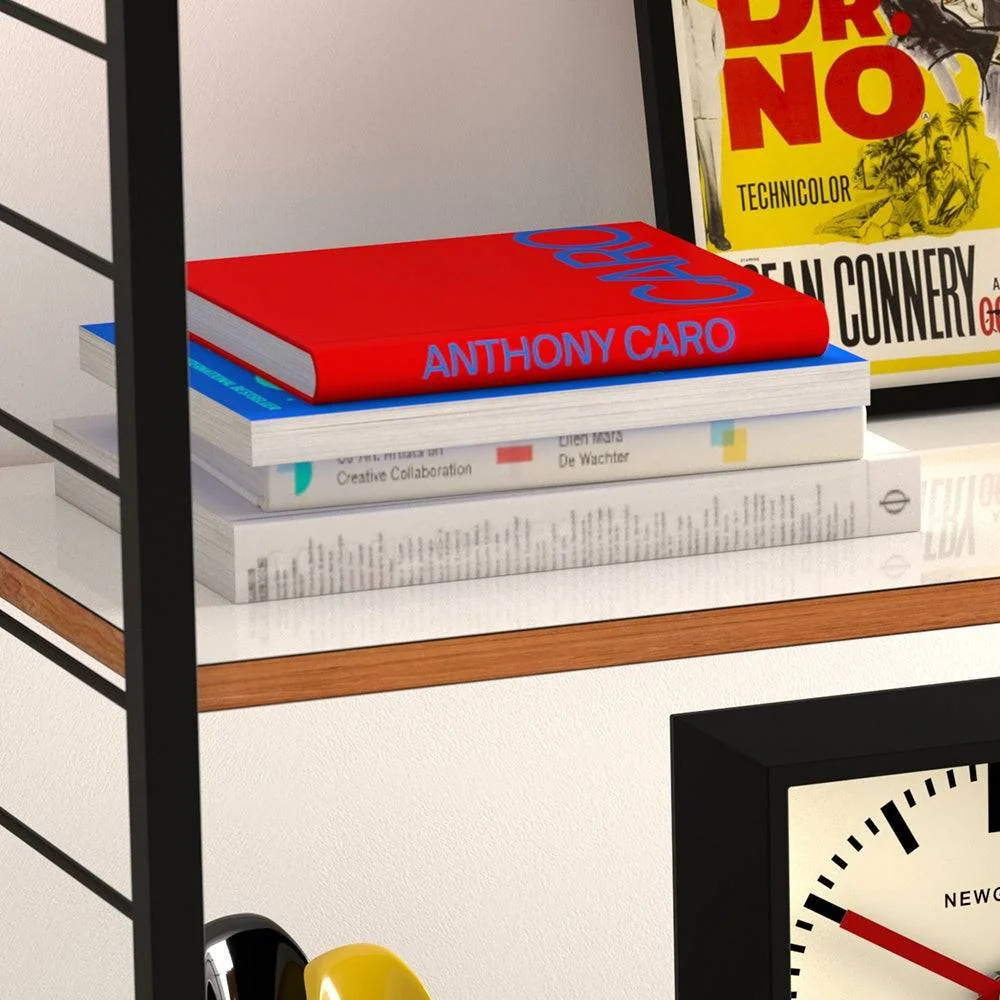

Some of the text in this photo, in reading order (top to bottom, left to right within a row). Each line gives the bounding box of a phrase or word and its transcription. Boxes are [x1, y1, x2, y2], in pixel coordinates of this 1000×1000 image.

[723, 45, 926, 151] NO
[737, 174, 852, 211] TECHNICOLOR
[513, 225, 755, 305] CARO
[833, 245, 976, 347] CONNERY
[422, 316, 736, 381] ANTHONY CARO
[337, 463, 472, 486] Creative Collaboration
[559, 450, 630, 468] De Wachter
